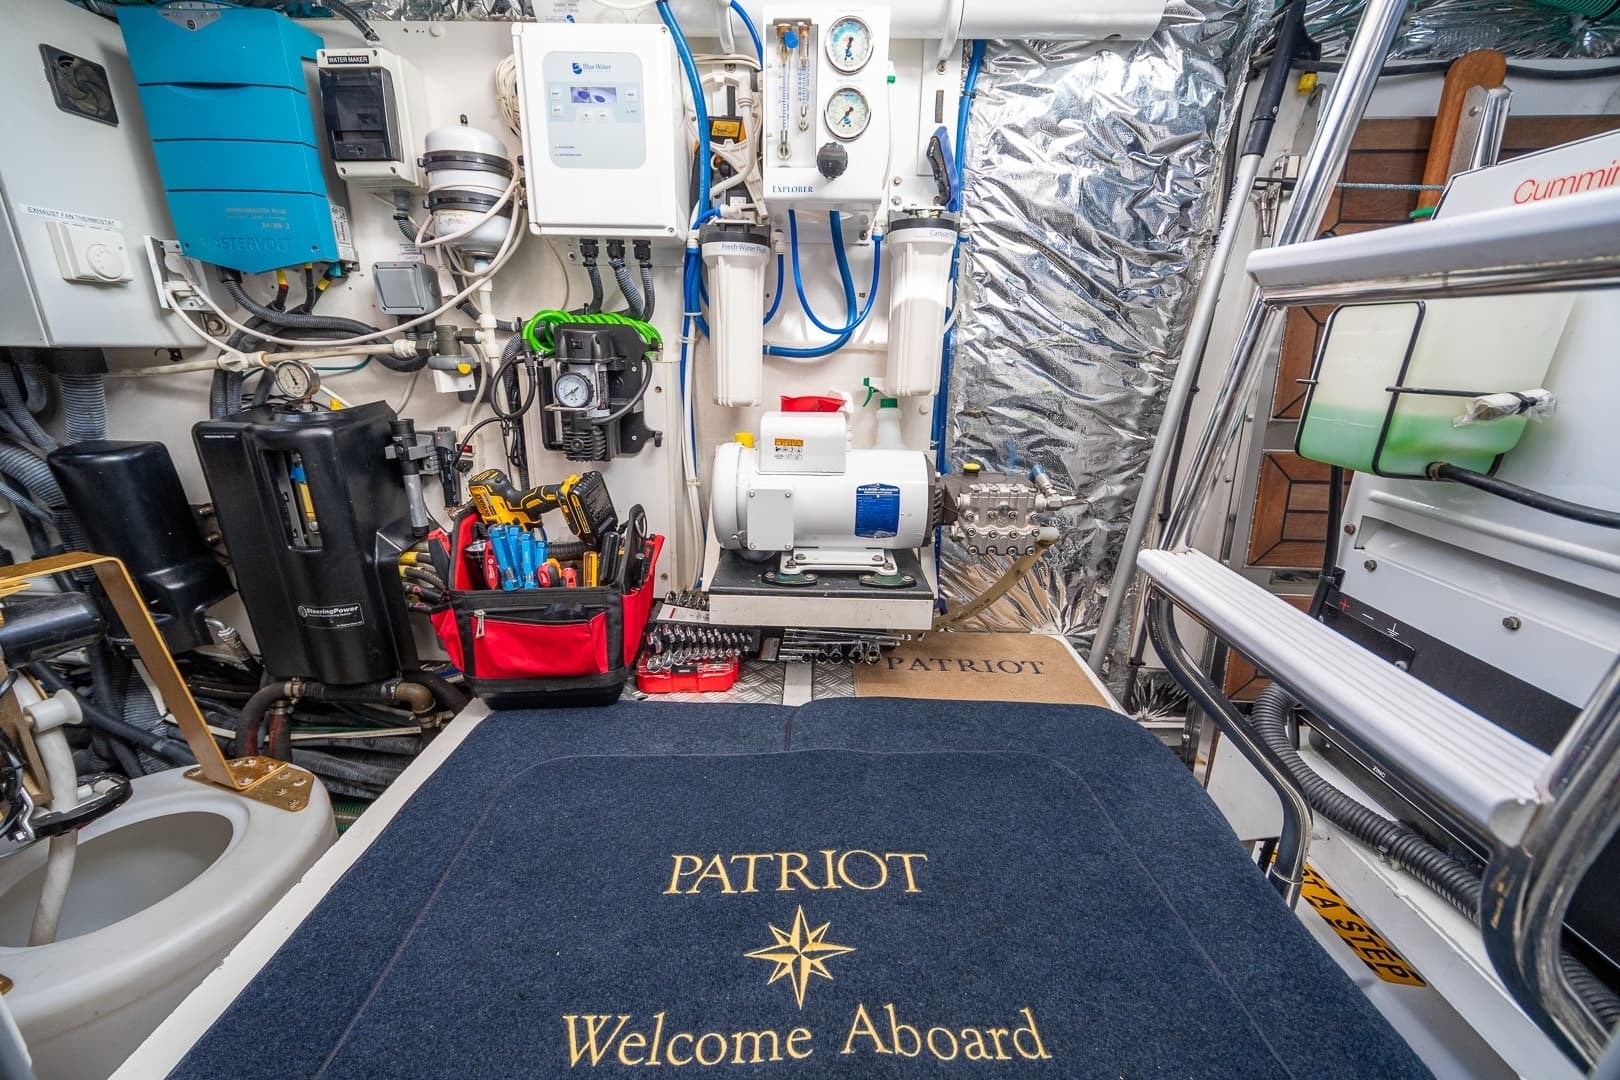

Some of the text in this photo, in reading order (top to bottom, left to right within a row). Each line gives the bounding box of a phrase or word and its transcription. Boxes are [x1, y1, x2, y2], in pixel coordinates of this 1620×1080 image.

[328, 56, 347, 64] WATER
[772, 185, 814, 193] EXPLORER
[27, 206, 115, 225] EXHAUST FAN THERMOSTAT
[721, 242, 738, 250] Fresh
[738, 243, 756, 251] Water
[306, 606, 358, 615] SteeringPower
[886, 656, 1045, 675] PATRIOT
[662, 850, 928, 895] PATRIOT
[1310, 895, 1410, 978] A STEP
[562, 1003, 1052, 1068] Welcome Aboard
